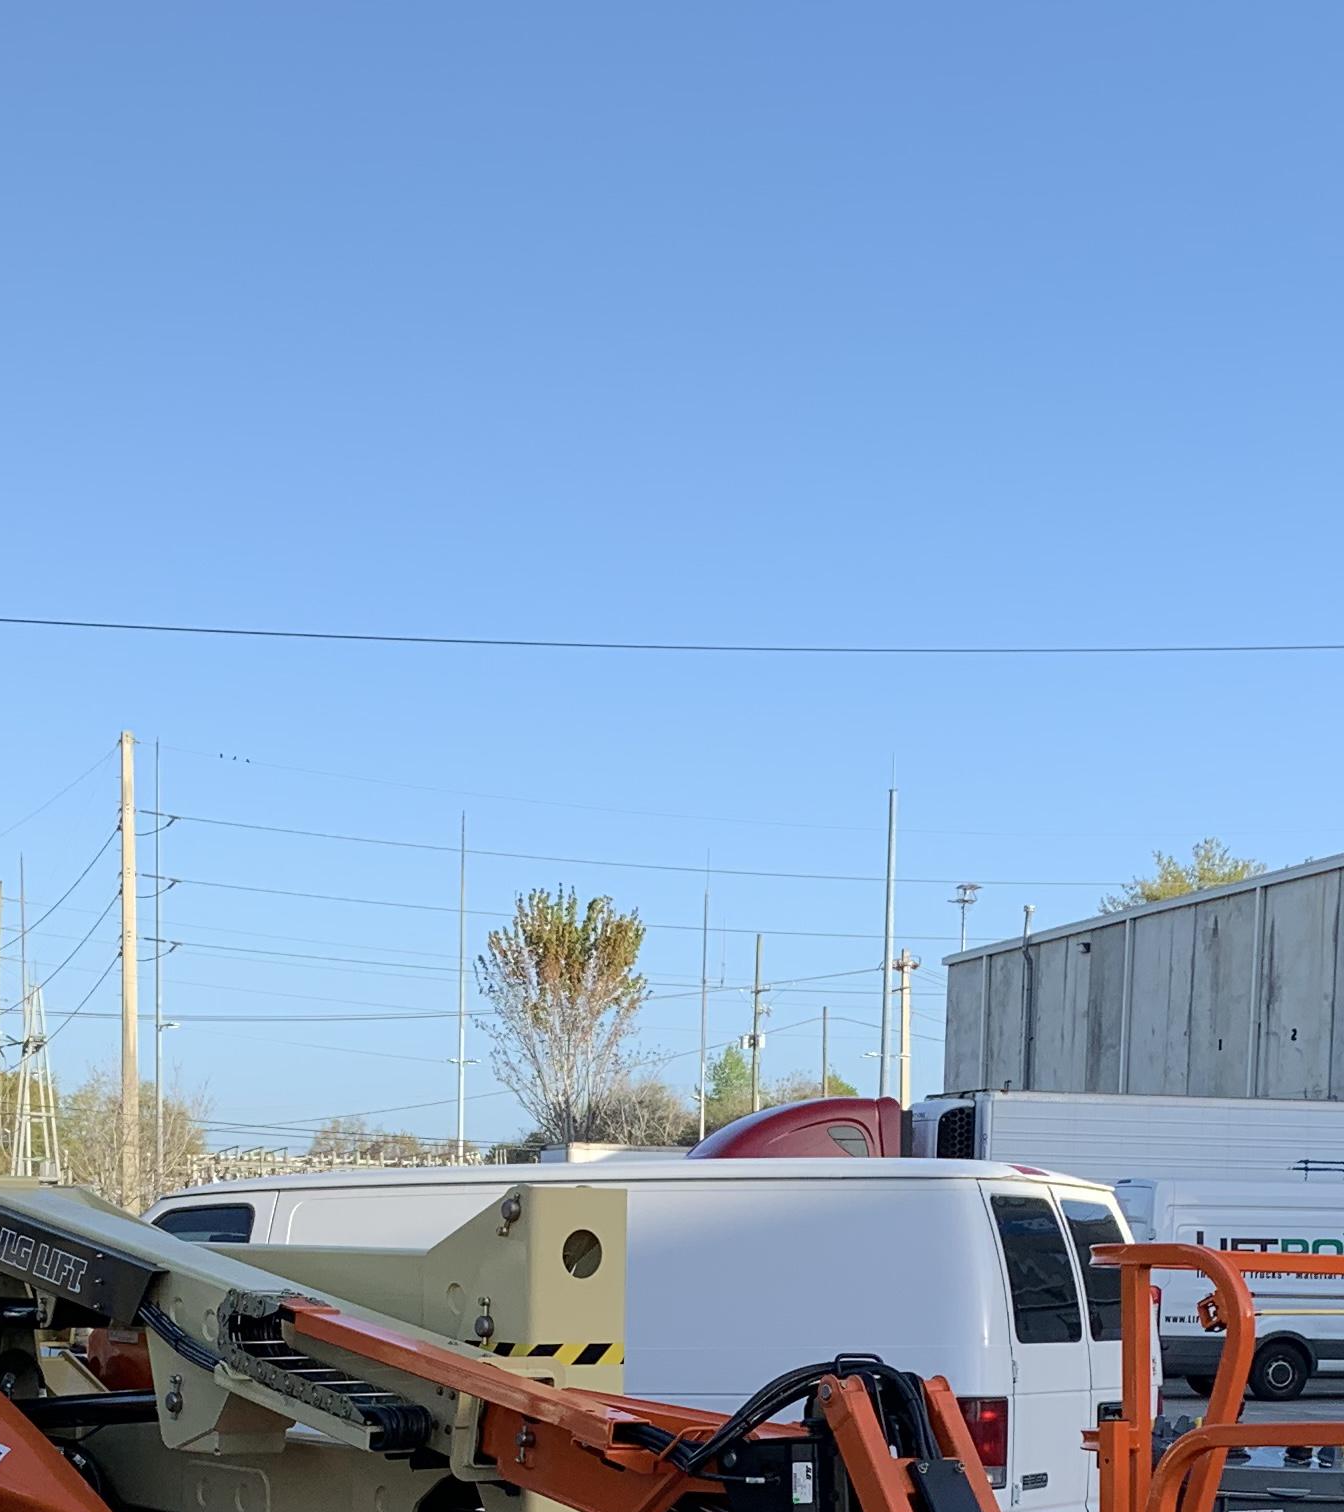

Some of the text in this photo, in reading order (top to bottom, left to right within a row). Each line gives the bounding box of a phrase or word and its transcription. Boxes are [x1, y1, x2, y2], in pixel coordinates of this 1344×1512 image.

[1291, 1028, 1297, 1042] 2
[1218, 1039, 1223, 1051] 1
[33, 1243, 89, 1293] LIFT
